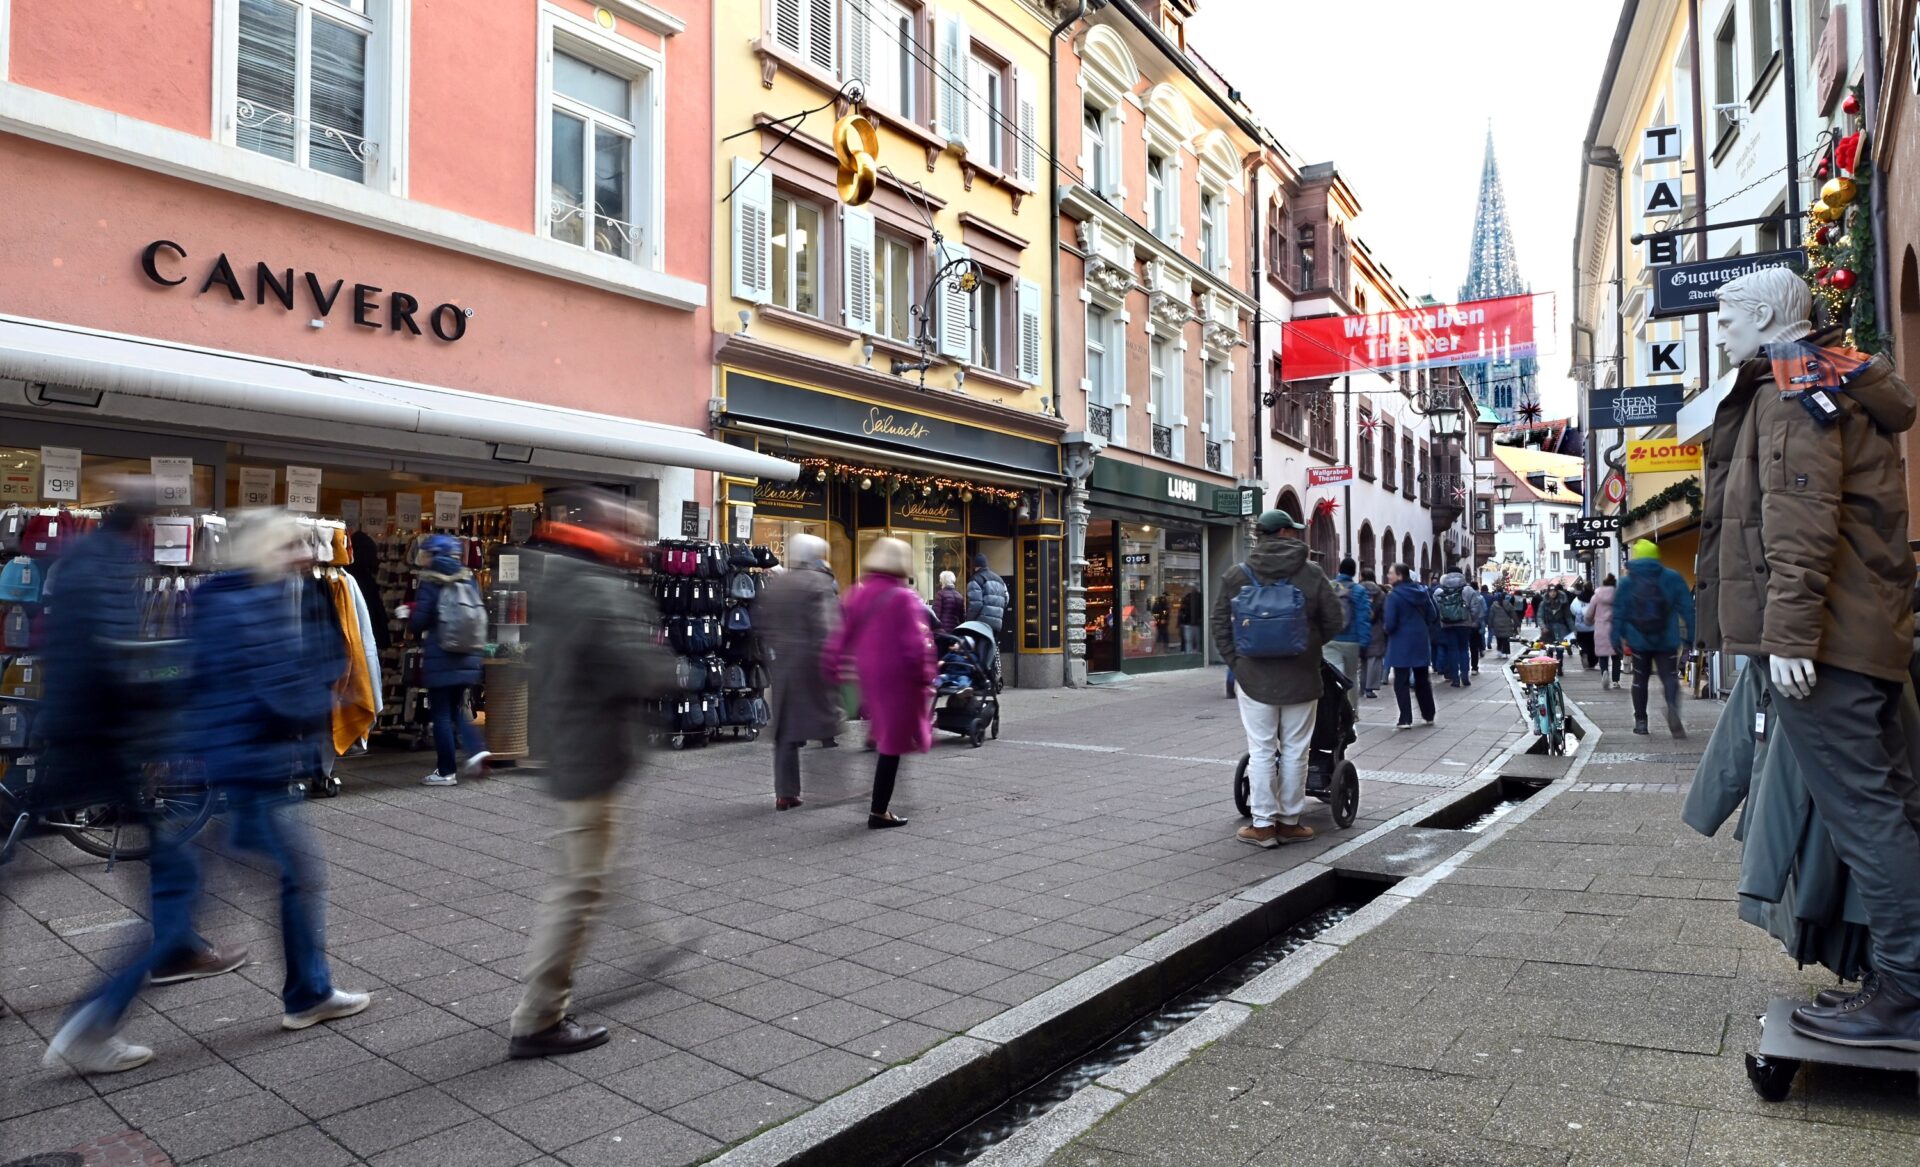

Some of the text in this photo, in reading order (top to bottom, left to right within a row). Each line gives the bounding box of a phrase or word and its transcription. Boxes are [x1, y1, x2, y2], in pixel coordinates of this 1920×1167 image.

[1646, 127, 1681, 371] TABK
[1343, 308, 1485, 338] Walgraben
[1364, 335, 1460, 359] Theter
[1612, 395, 1657, 408] STEFAN
[1621, 405, 1657, 415] MEIER
[1650, 445, 1698, 458] LOTTO
[1313, 469, 1348, 477] Wallgraben
[754, 481, 807, 500] eilnacht
[1168, 477, 1197, 501] LUSH
